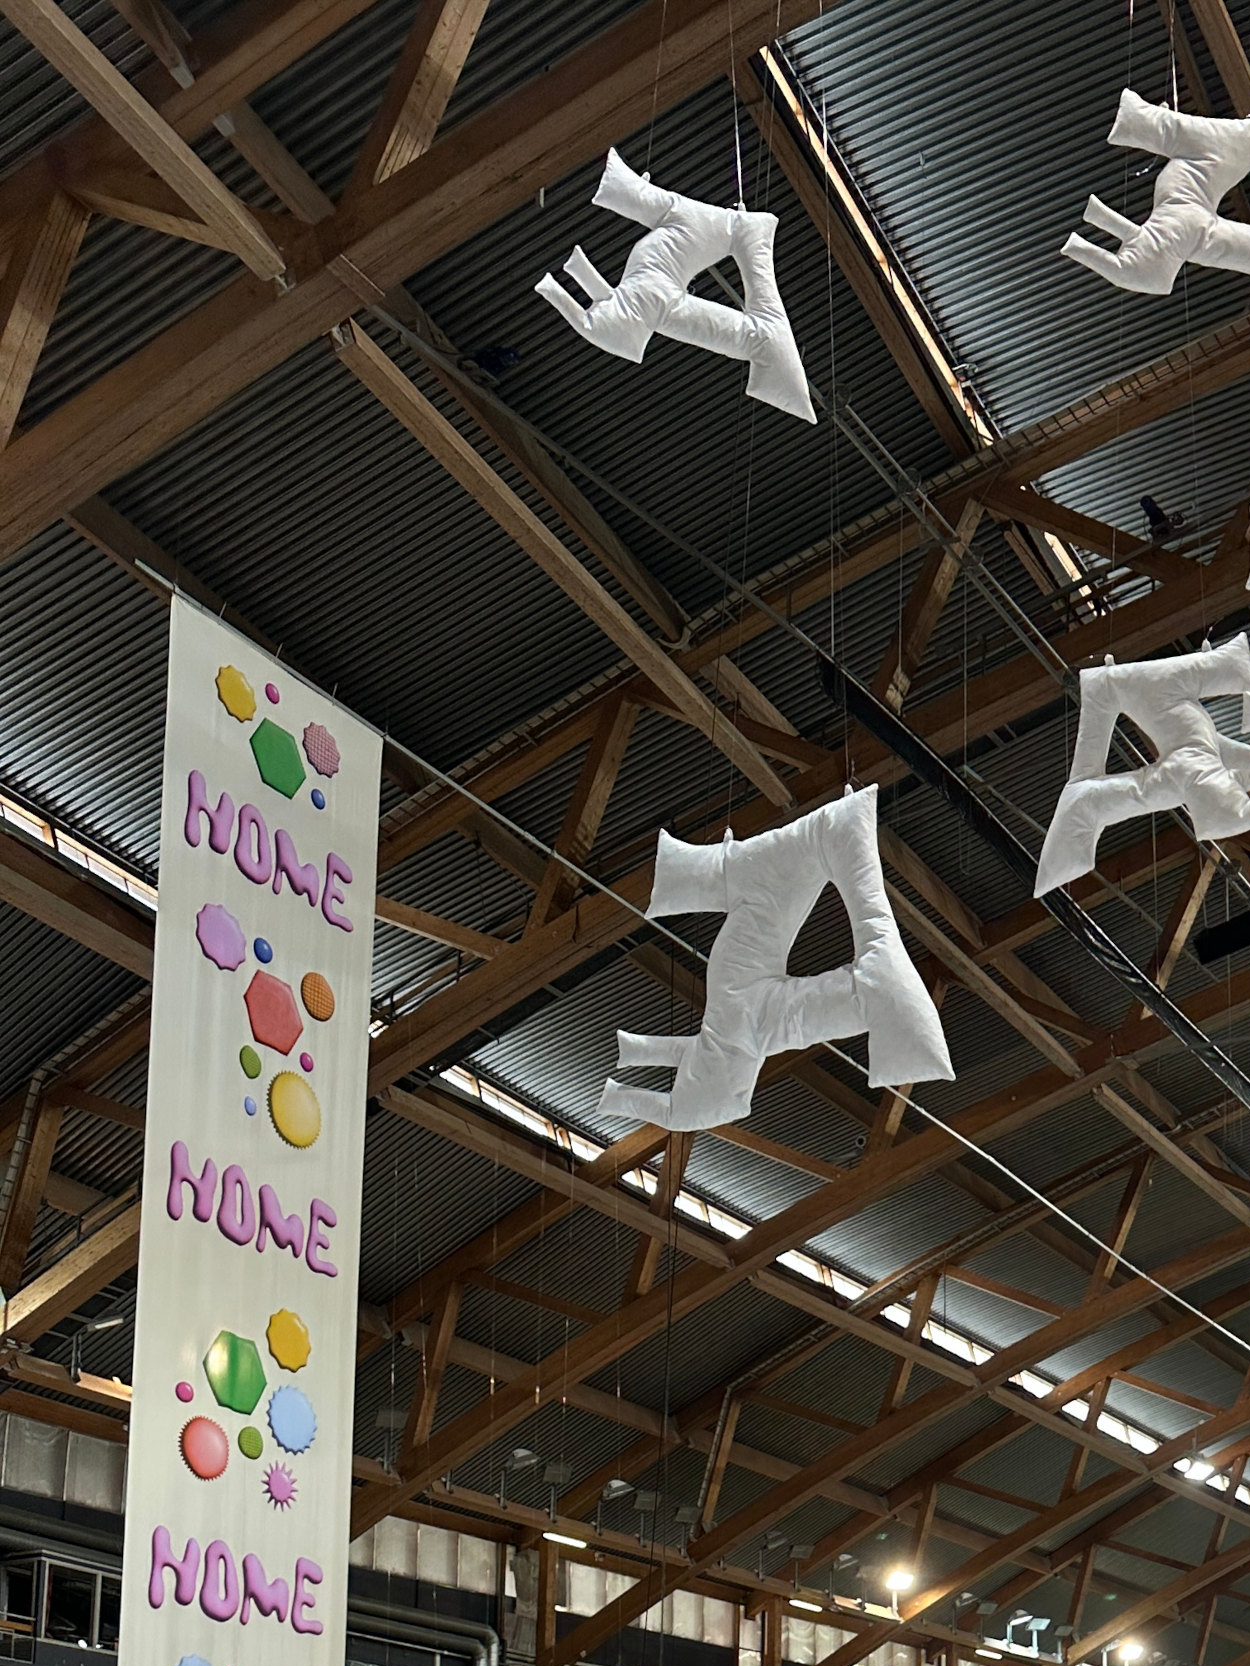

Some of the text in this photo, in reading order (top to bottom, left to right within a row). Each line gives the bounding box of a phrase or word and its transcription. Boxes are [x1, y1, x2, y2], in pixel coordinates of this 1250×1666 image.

[184, 769, 354, 932] HOME
[166, 1140, 338, 1277] HOME
[148, 1525, 324, 1635] HOME
